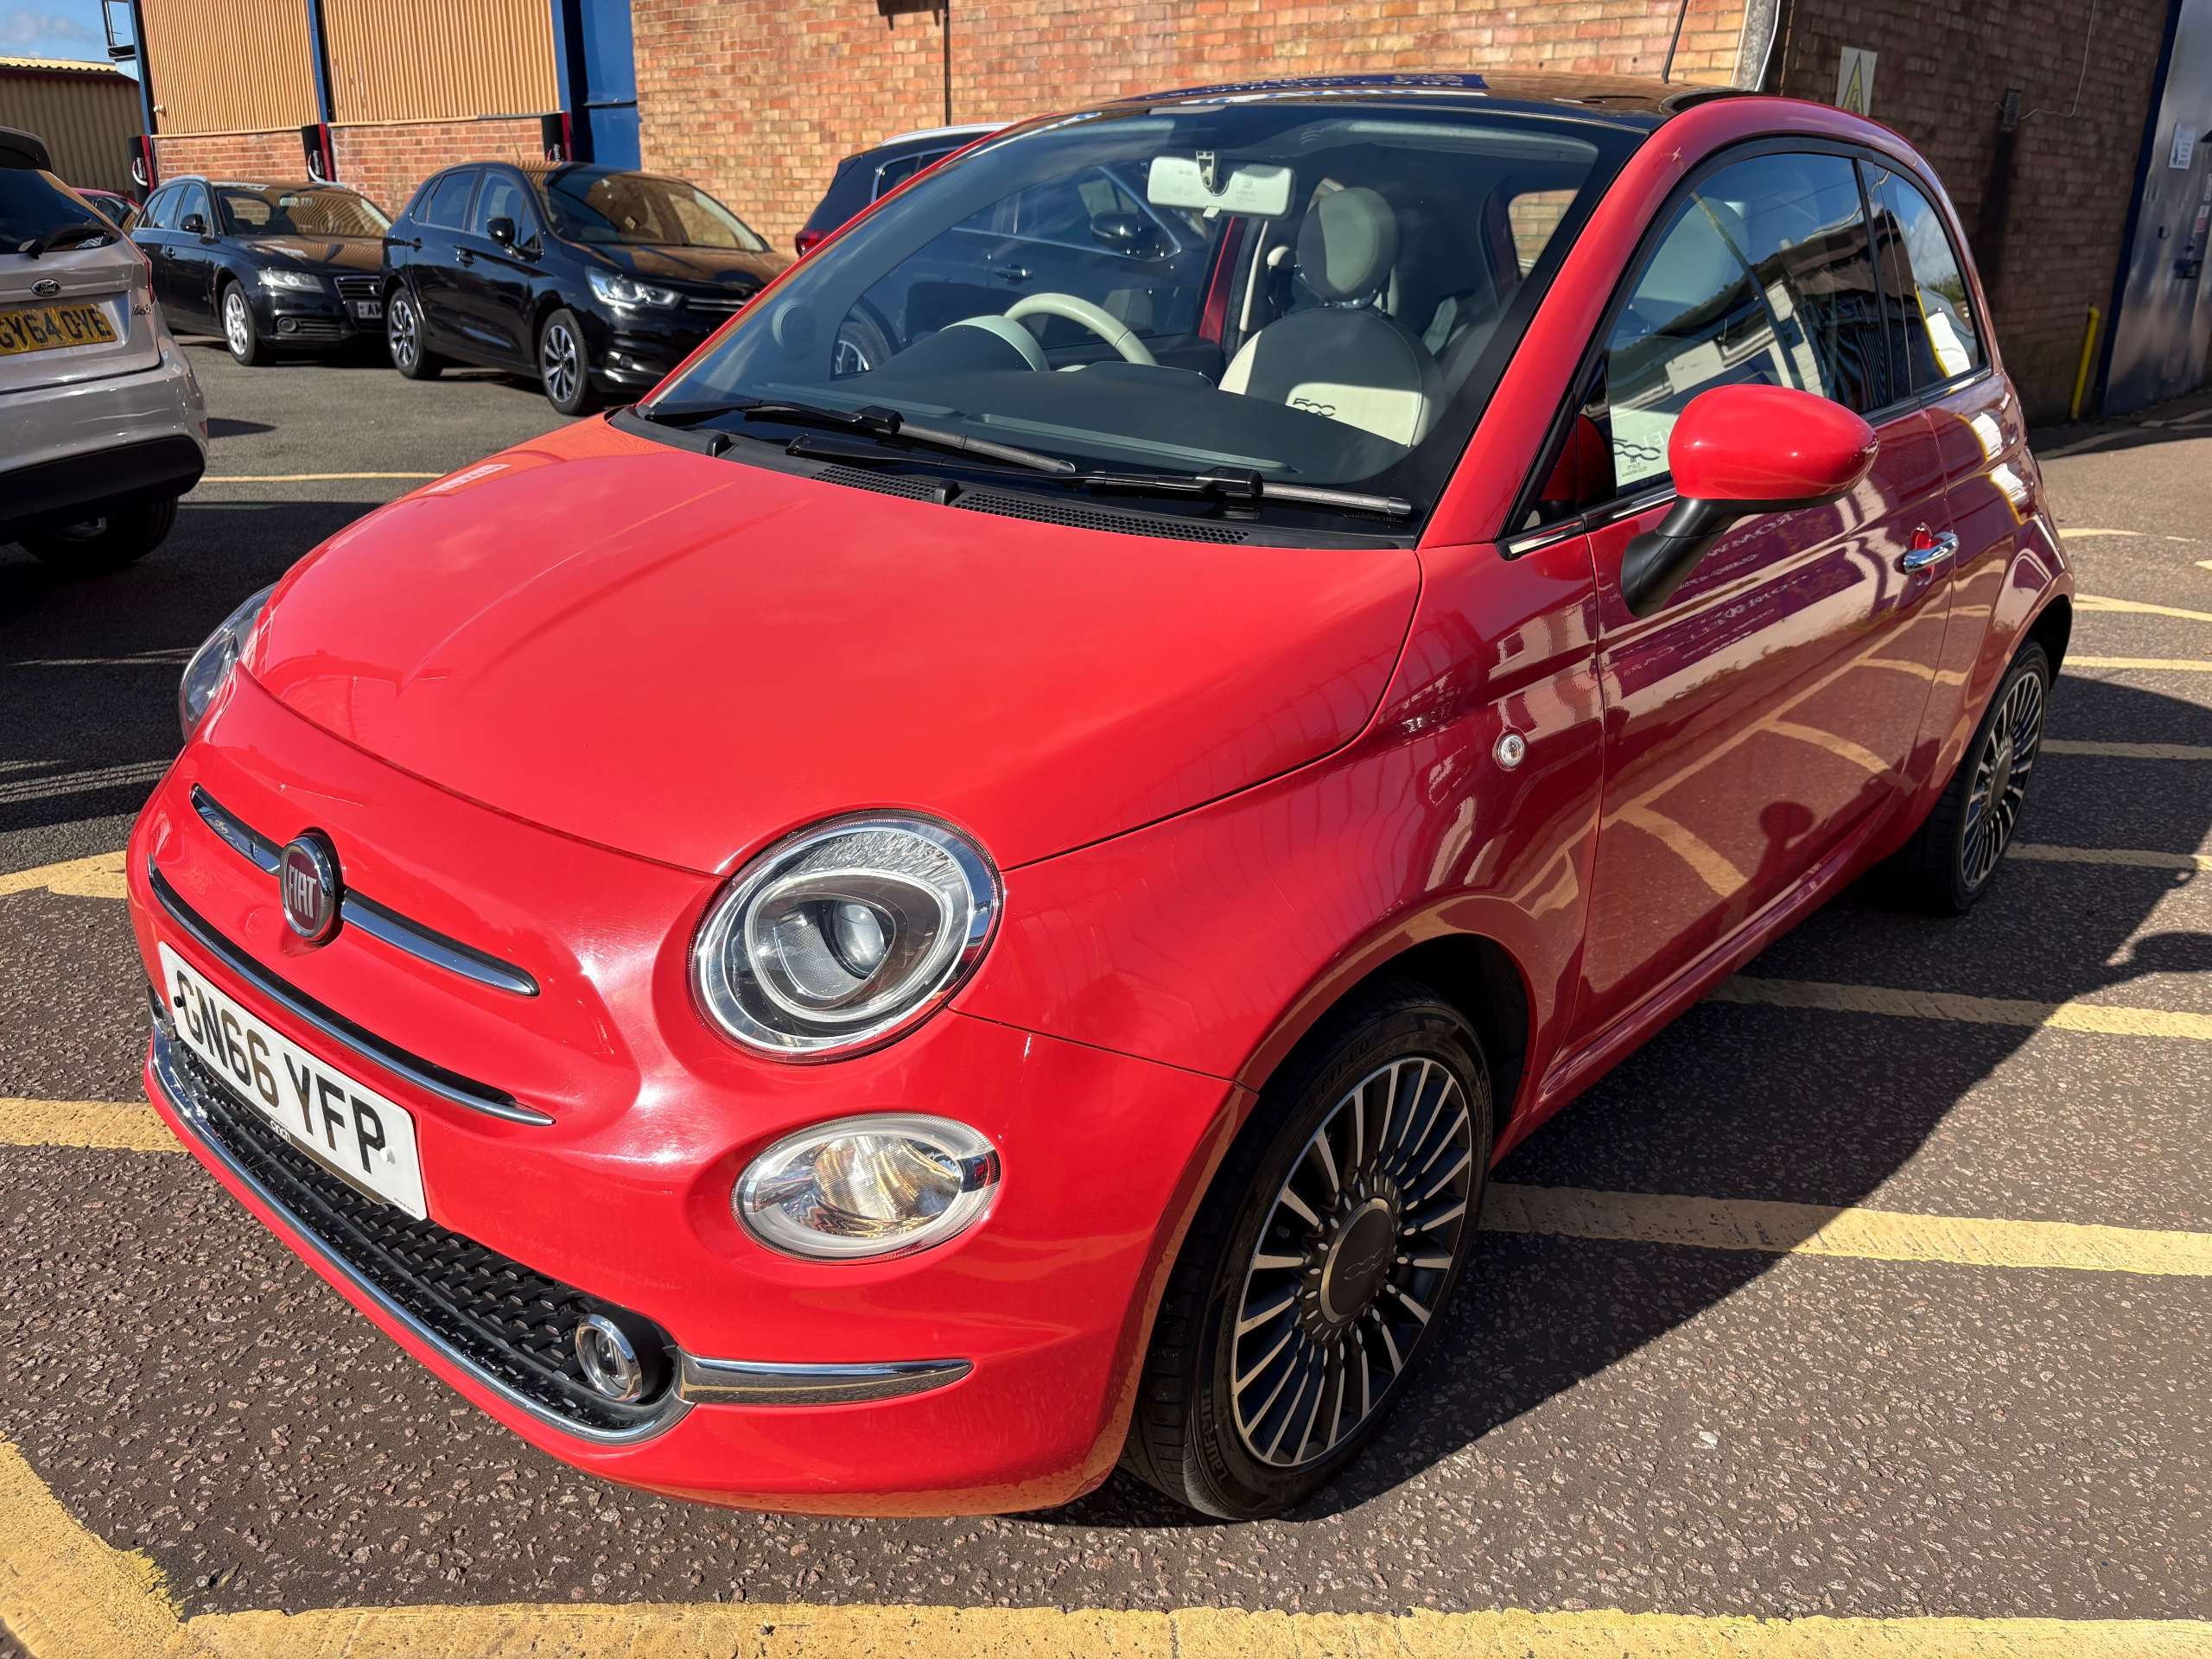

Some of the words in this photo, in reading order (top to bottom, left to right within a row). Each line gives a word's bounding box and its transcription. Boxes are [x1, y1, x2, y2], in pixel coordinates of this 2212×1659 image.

[1293, 397, 1336, 416] 500
[288, 864, 317, 919] FIAT
[176, 969, 280, 1109] GN66
[283, 1052, 386, 1175] YFP
